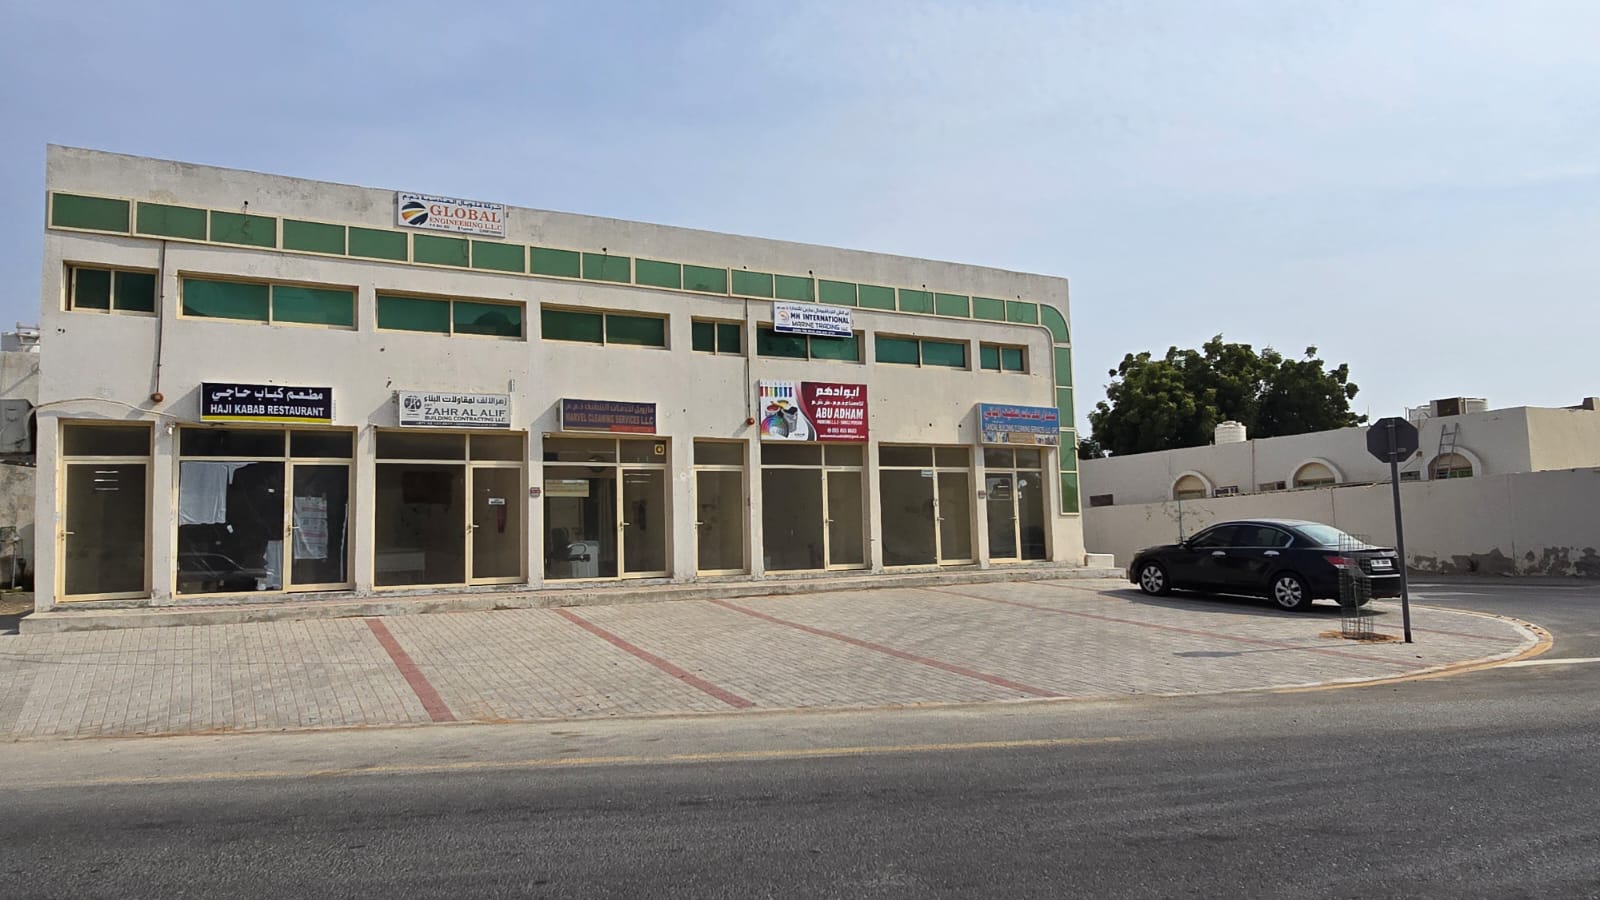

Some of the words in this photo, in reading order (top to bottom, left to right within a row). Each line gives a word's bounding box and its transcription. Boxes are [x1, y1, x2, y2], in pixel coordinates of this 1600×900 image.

[430, 204, 500, 223] GLOBAL
[430, 217, 484, 228] ENGINEERING
[803, 314, 849, 324] INTERNATIONAL
[212, 386, 251, 401] حاجي
[254, 387, 284, 401] كباب
[287, 388, 323, 402] مطعم
[424, 395, 440, 404] البناء
[210, 404, 232, 413] HAJI
[234, 404, 265, 414] KABAB
[267, 406, 324, 416] RESTAURANT
[424, 407, 458, 416] ZAHR
[816, 408, 833, 418] ABU
[834, 408, 863, 420] ADHAM
[588, 414, 615, 423] CLEANING
[616, 415, 639, 424] SERVICES
